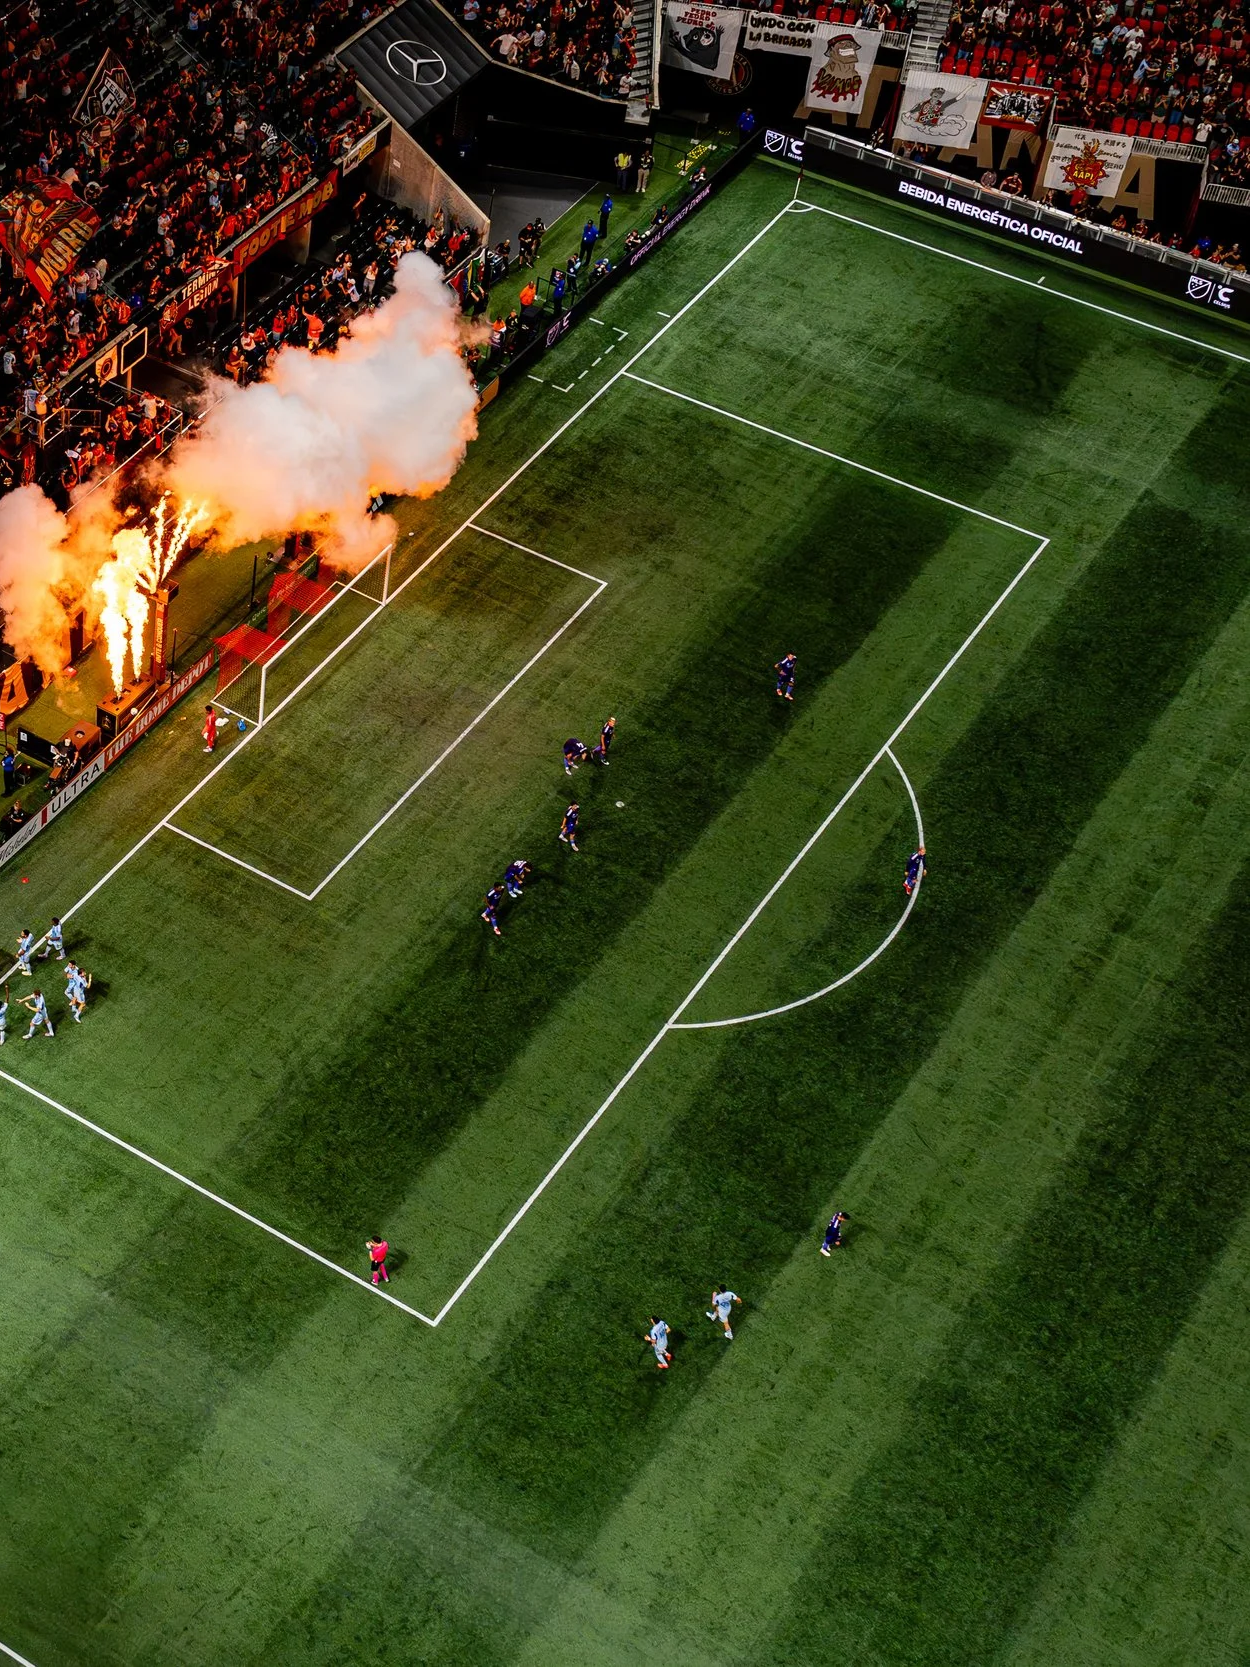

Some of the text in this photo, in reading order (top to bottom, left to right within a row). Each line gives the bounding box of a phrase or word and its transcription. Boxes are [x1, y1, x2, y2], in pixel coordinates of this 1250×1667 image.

[676, 16, 704, 27] PEDRO
[690, 7, 717, 18] PEDRO
[750, 15, 816, 34] UNIDO CON
[749, 31, 812, 49] LA BRIGADA
[1072, 170, 1094, 180] AAPI
[239, 181, 334, 266] FOOTIE MOB
[898, 181, 1084, 254] BEBIDA ENERGÉTICA OFICIAL
[35, 218, 93, 292] ABOARD
[188, 277, 219, 311] LEGION
[105, 659, 210, 762] THE HOME DEPOT
[51, 762, 101, 813] ULTRA
